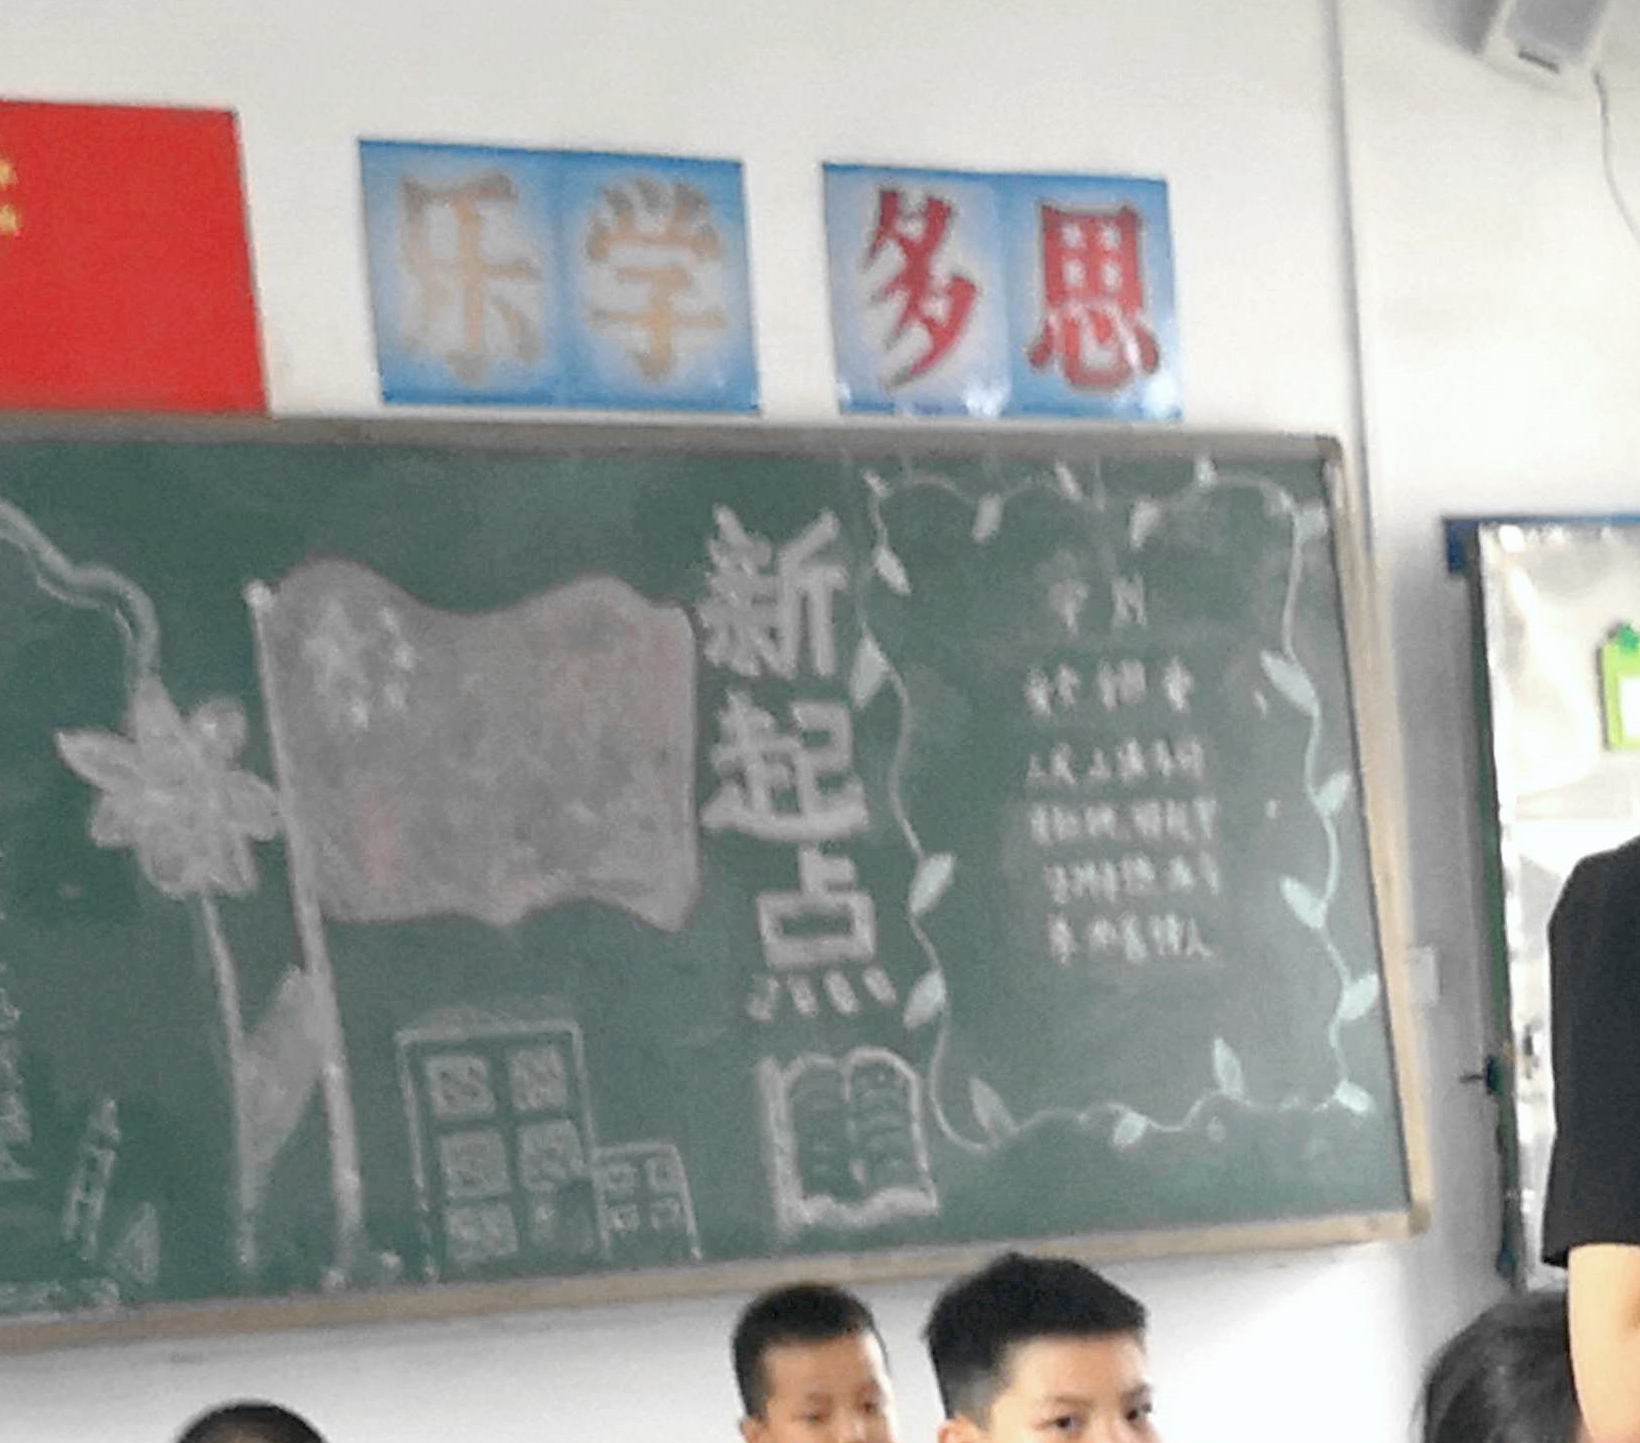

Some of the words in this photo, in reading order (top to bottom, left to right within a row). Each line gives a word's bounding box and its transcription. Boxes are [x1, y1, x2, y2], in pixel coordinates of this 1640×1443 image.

[398, 172, 726, 380] 乐学
[864, 186, 1162, 392] 多思
[696, 504, 897, 1022] 新起点
